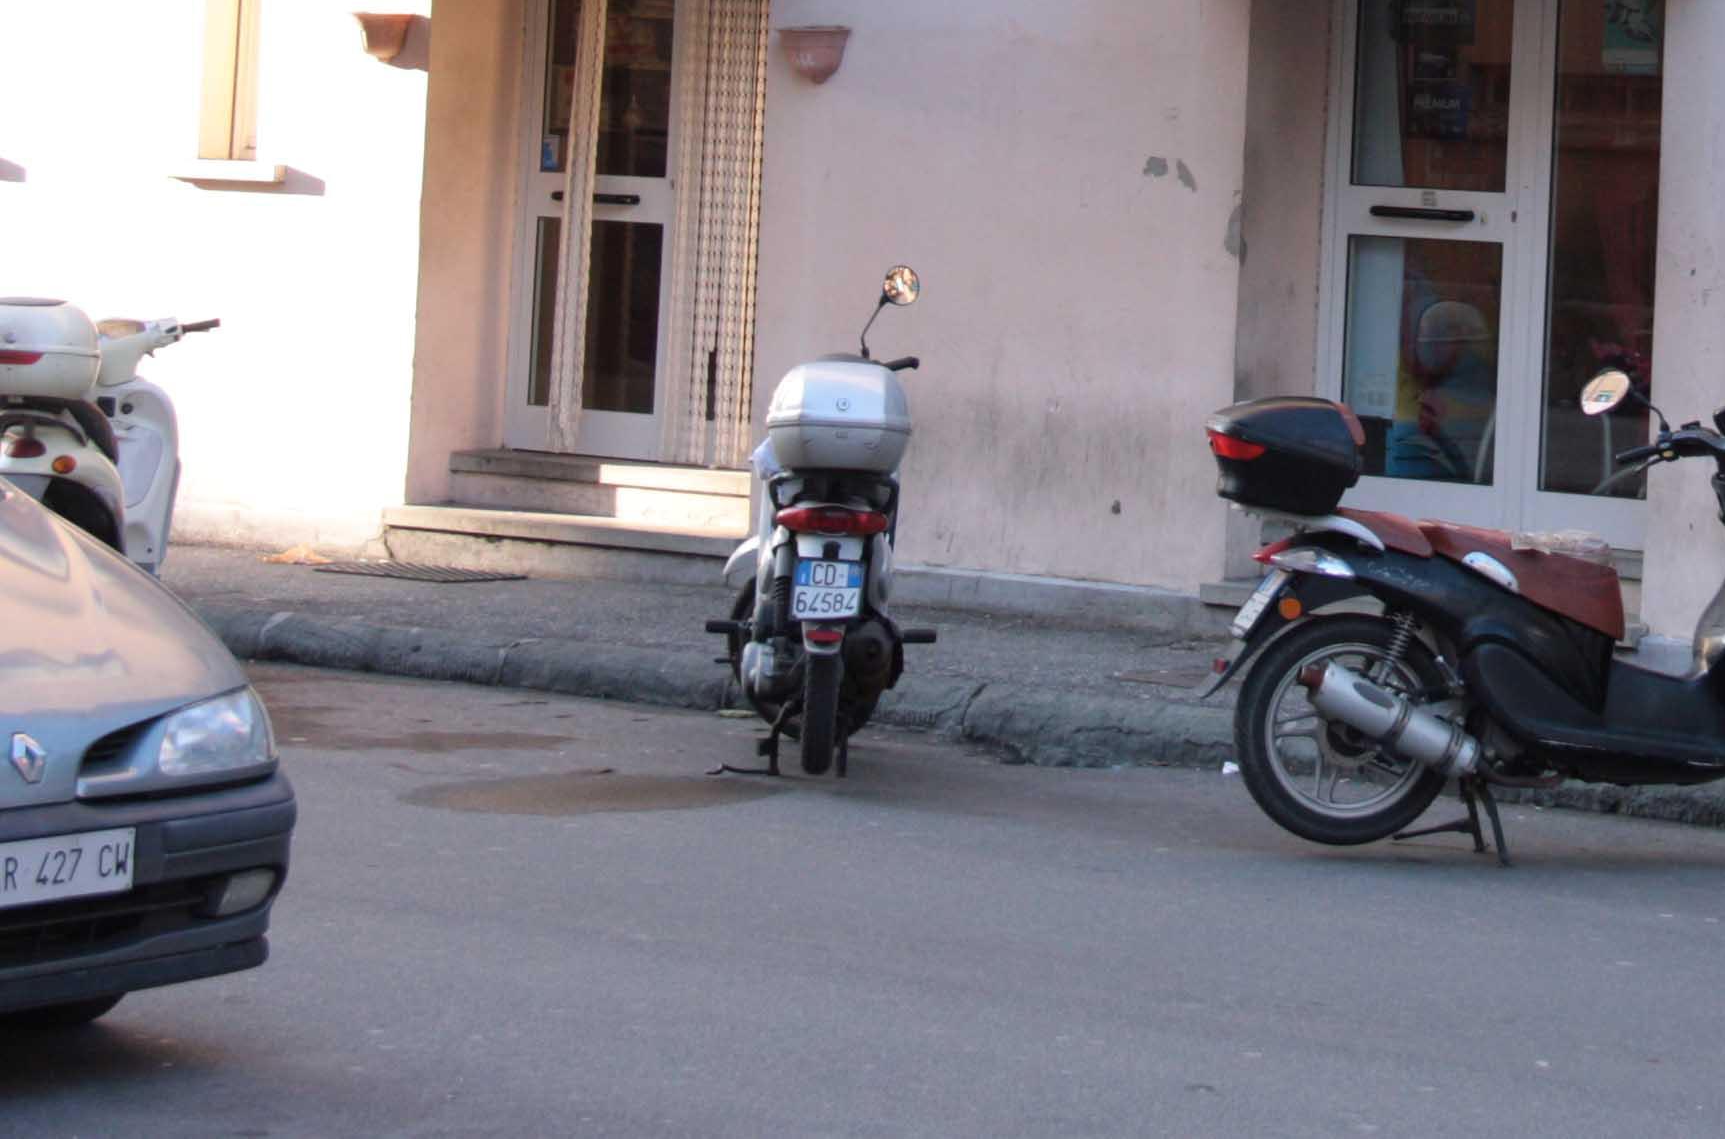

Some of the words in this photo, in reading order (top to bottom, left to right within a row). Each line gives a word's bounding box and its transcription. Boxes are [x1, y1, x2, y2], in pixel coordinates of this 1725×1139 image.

[795, 591, 857, 613] 64584
[35, 847, 83, 885] 427
[98, 842, 130, 878] CW
